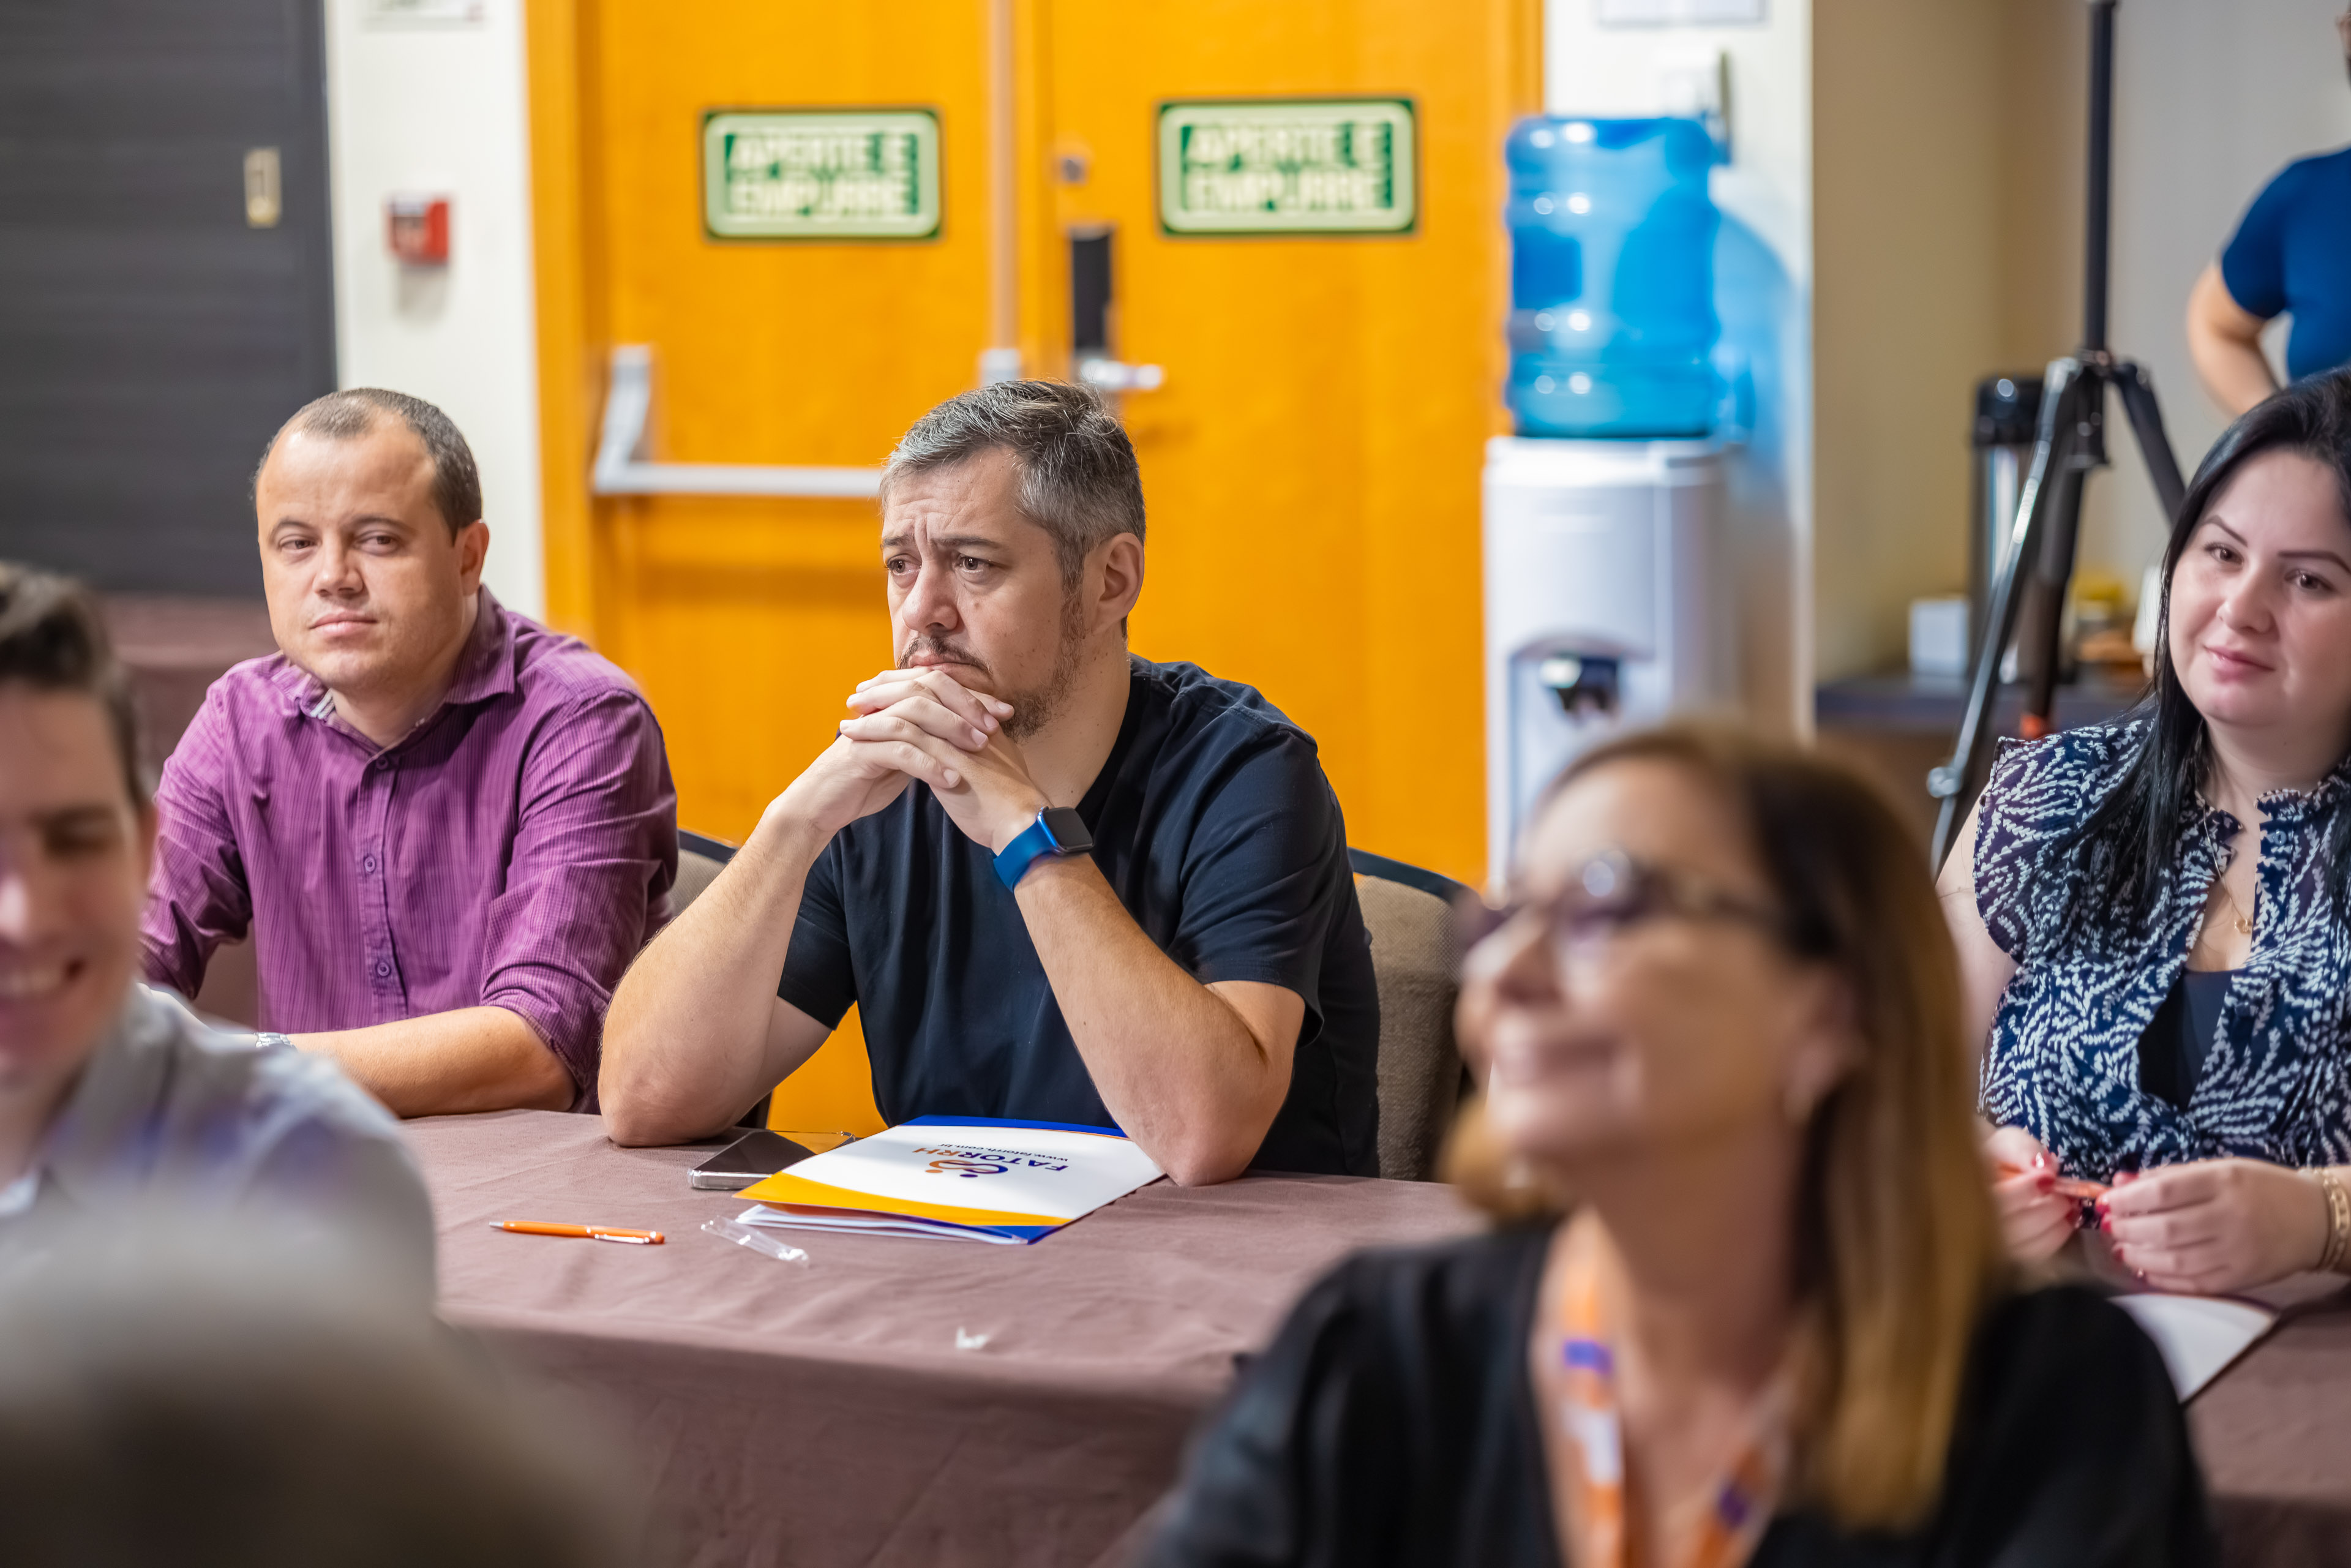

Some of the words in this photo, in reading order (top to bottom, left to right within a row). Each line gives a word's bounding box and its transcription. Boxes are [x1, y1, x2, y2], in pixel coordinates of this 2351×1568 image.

[729, 133, 872, 171] APERTE
[880, 133, 910, 171] E
[1184, 124, 1341, 168] APERTE
[1351, 124, 1382, 167] E
[937, 1143, 1068, 1162] www.fatorrh.com.br
